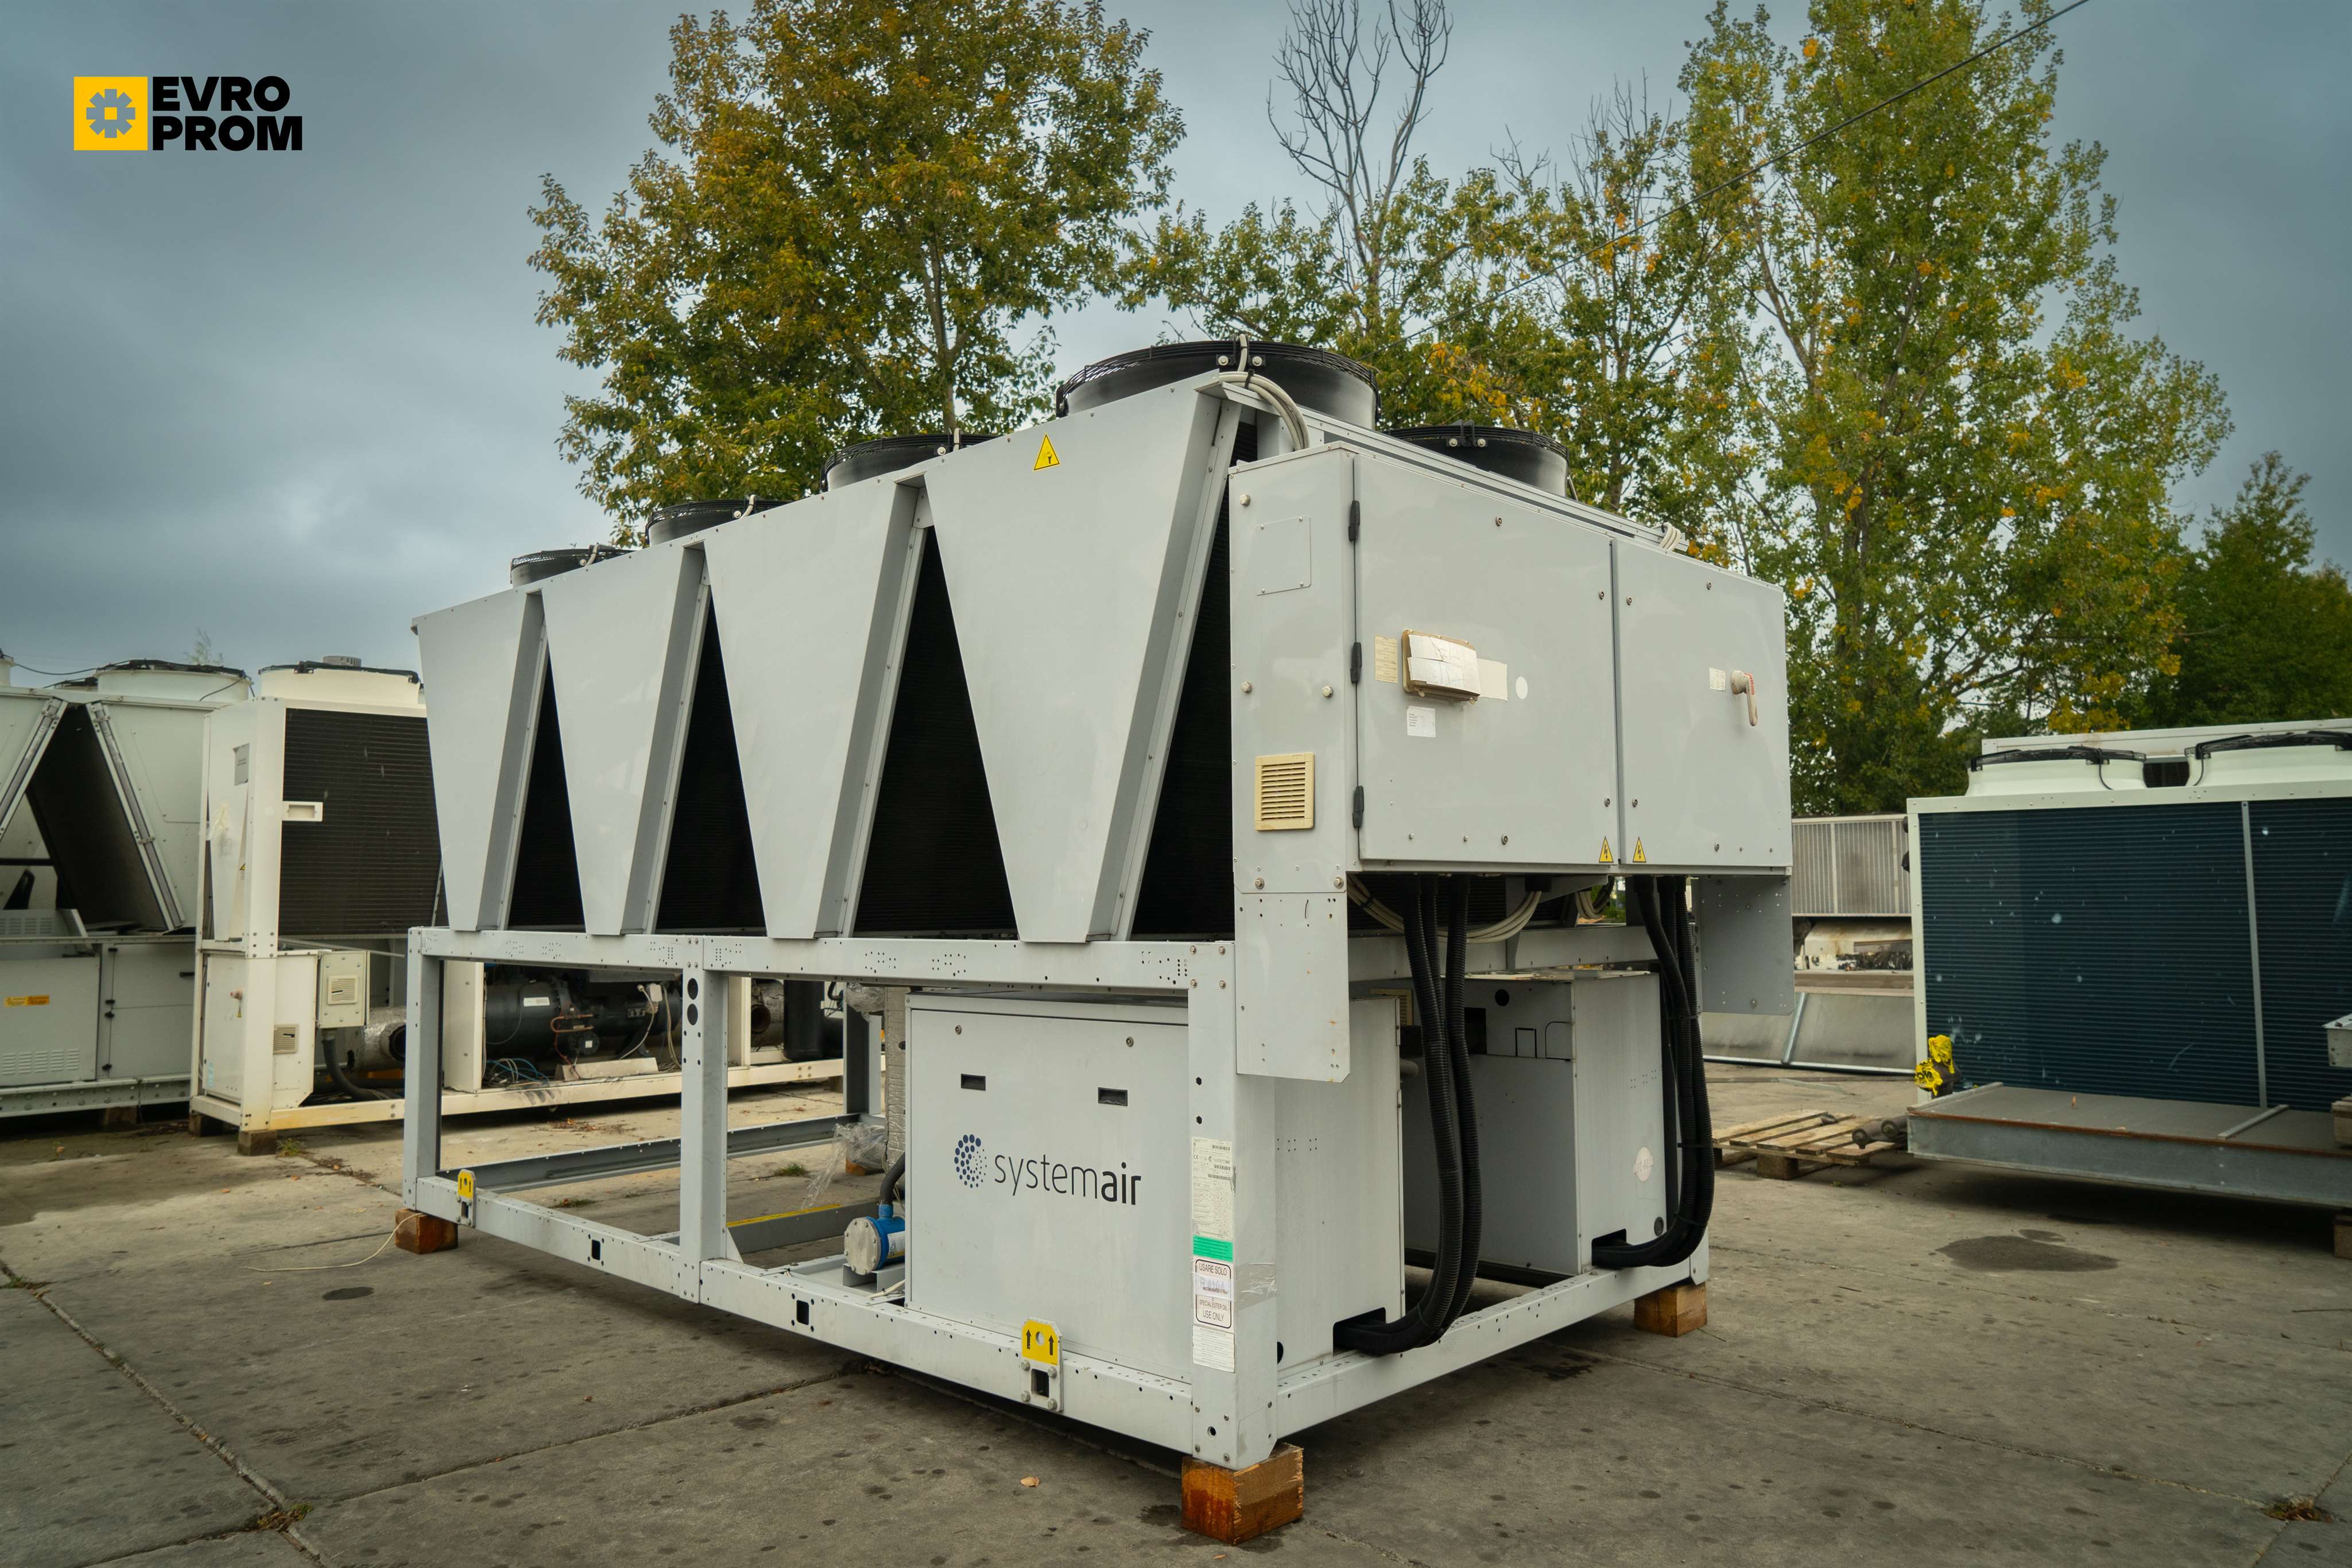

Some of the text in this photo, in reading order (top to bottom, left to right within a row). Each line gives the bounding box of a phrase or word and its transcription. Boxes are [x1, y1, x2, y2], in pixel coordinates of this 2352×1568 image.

[994, 1154, 1142, 1205] systemair
[1199, 1263, 1227, 1276] USARE SOLO
[1199, 1299, 1212, 1307] SPECIAL
[1203, 1310, 1225, 1321] USE ONLY
